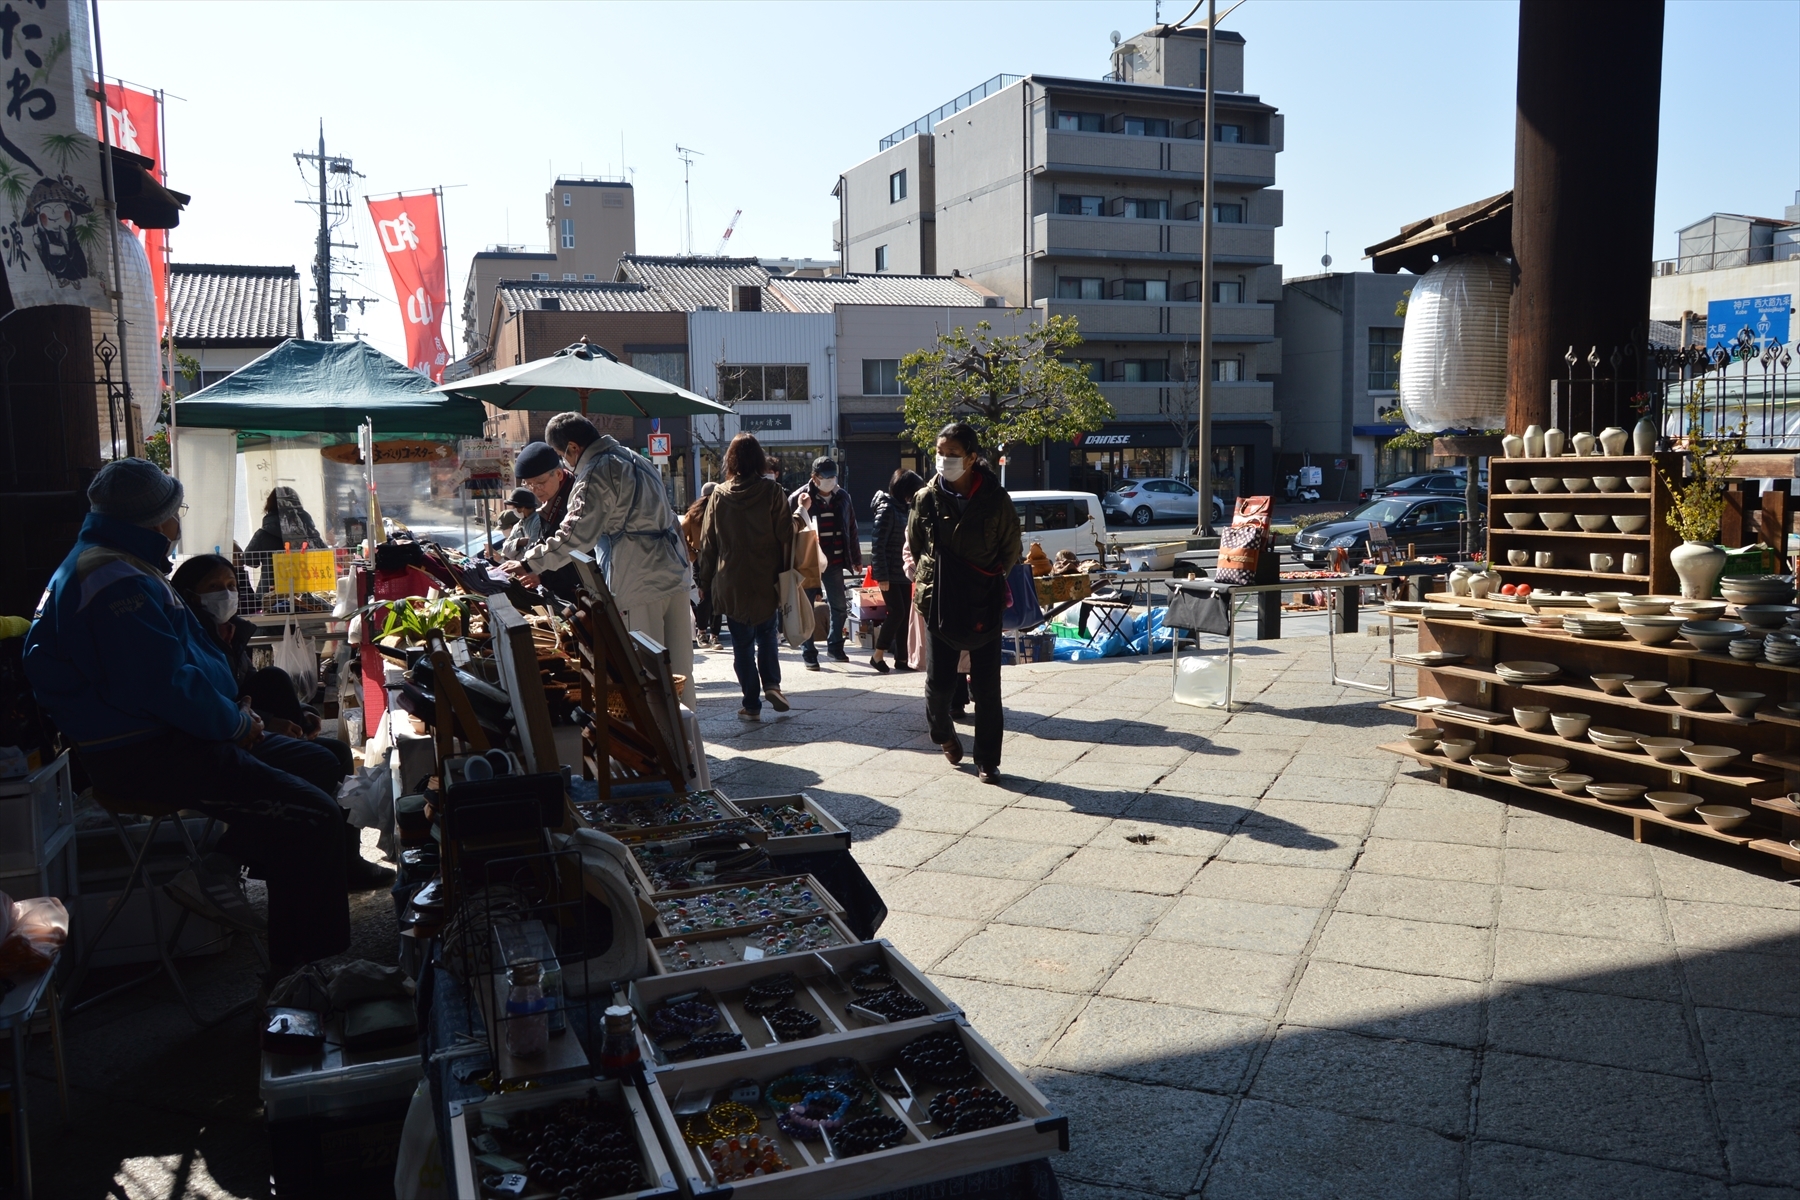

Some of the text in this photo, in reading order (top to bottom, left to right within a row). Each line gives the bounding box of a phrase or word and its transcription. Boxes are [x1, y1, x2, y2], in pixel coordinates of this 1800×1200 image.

[1733, 295, 1791, 310] 神戸 西大路九条
[1708, 323, 1727, 334] 大阪
[1758, 323, 1769, 331] 171
